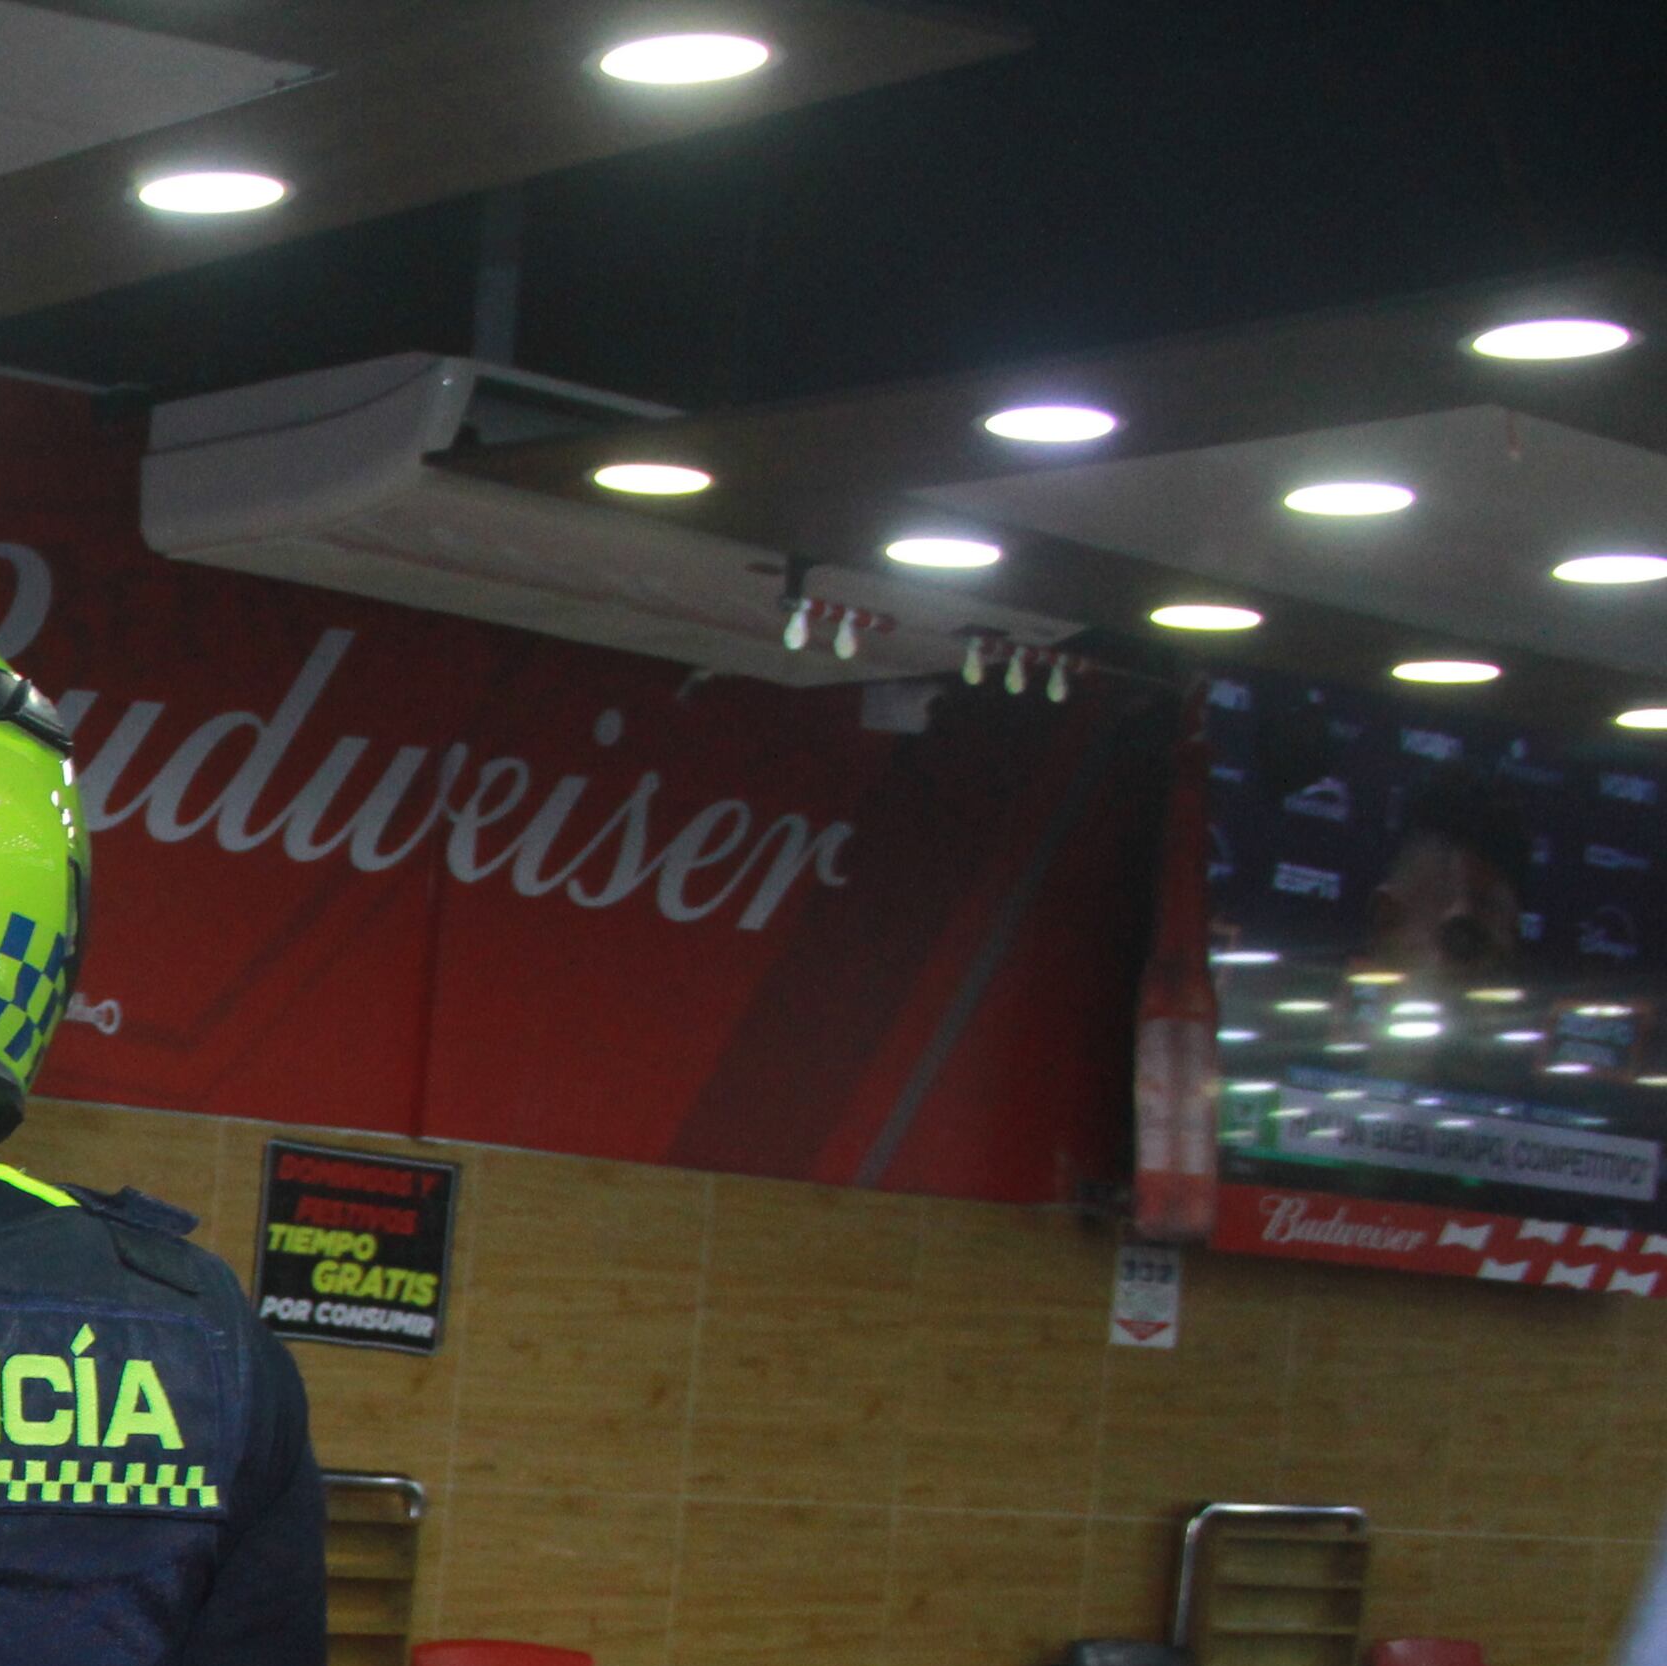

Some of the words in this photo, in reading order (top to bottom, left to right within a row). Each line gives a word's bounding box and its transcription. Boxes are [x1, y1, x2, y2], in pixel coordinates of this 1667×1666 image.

[268, 1222, 378, 1261] TIEMPO
[1260, 1195, 1429, 1254] Budweiser
[311, 1259, 438, 1307] GRATIS
[259, 1296, 313, 1322] POR
[315, 1301, 436, 1338] CONSUMIR
